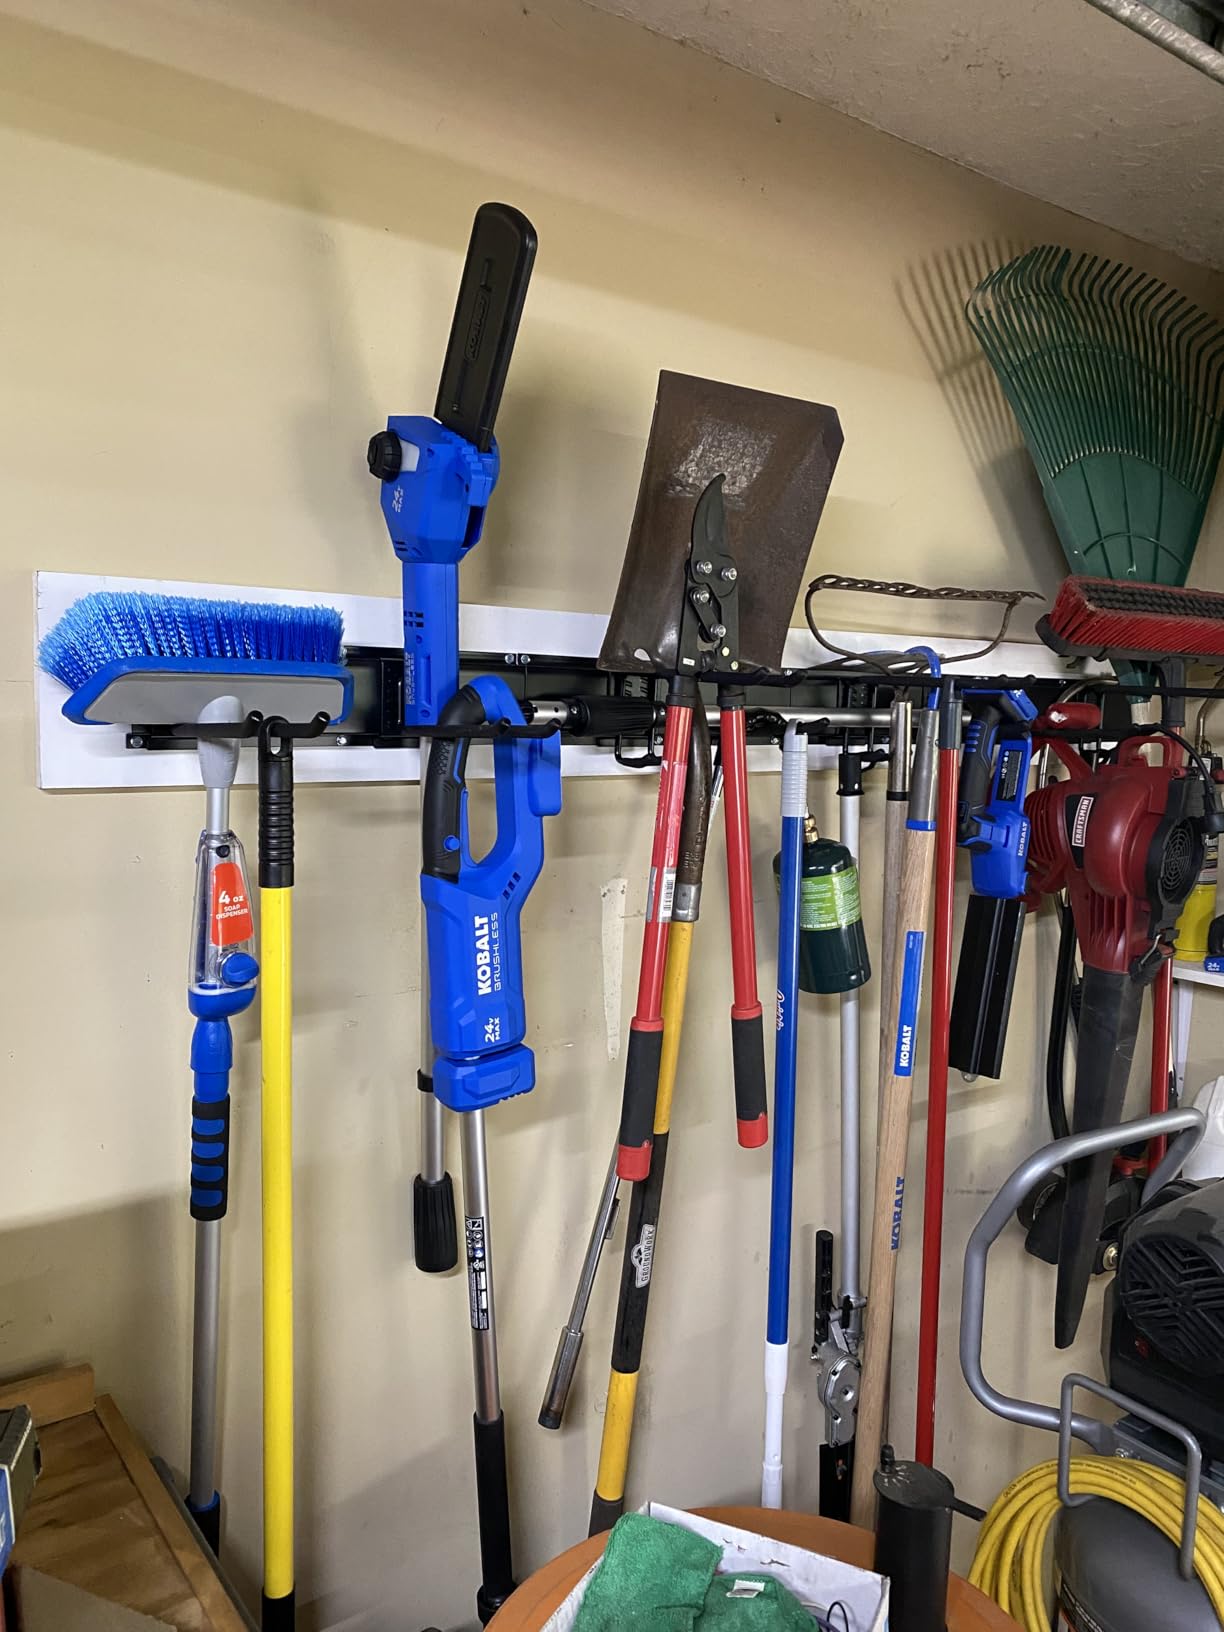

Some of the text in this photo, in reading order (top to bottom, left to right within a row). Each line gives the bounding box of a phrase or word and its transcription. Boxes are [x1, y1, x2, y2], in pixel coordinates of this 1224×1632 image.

[1017, 822, 1028, 857] KOBALT
[1075, 799, 1090, 843] CRAFTSMAN
[215, 908, 248, 919] DISPENSER
[219, 890, 230, 904] 4
[223, 904, 240, 912] SOAP
[475, 915, 492, 996] KOBALT
[491, 912, 502, 991] BRUSHLESS
[899, 1024, 913, 1067] KOBALT
